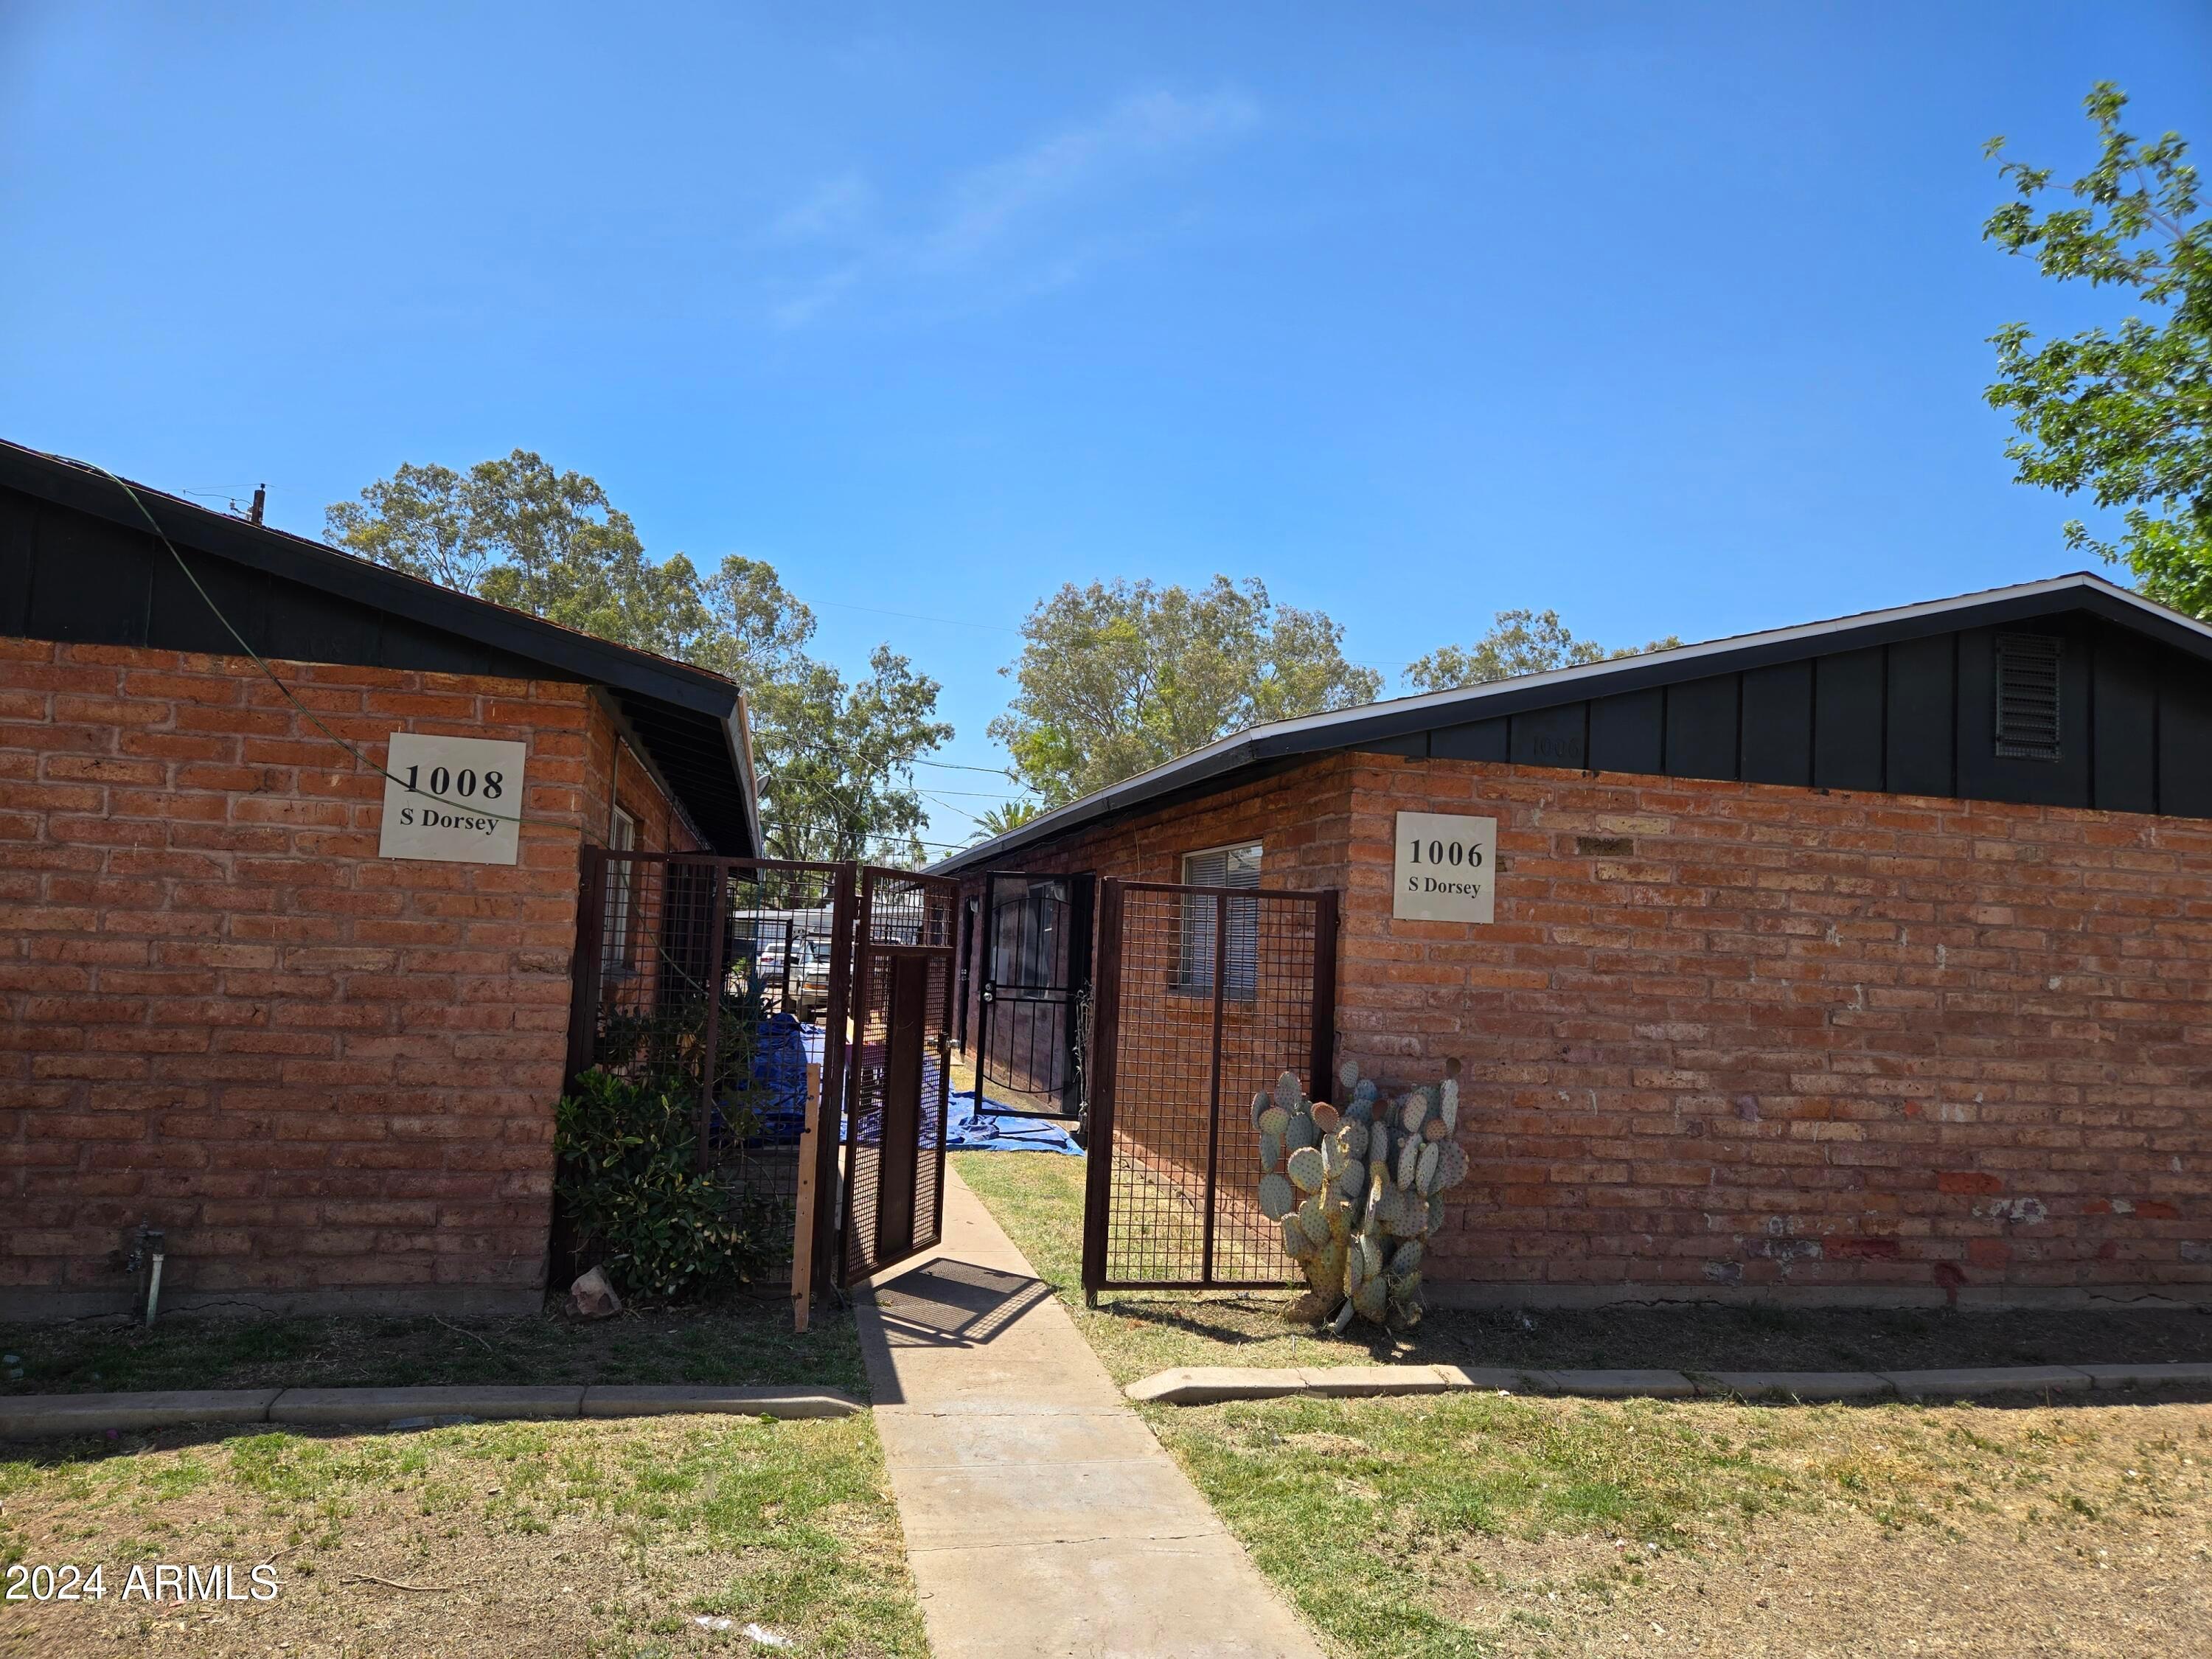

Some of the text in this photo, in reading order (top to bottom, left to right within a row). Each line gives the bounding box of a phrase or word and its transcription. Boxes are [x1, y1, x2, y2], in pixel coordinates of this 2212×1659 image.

[405, 765, 504, 799] 1008
[400, 807, 499, 835] S Dorsey
[1409, 839, 1483, 867] 1006
[1408, 876, 1481, 899] S Dorsey
